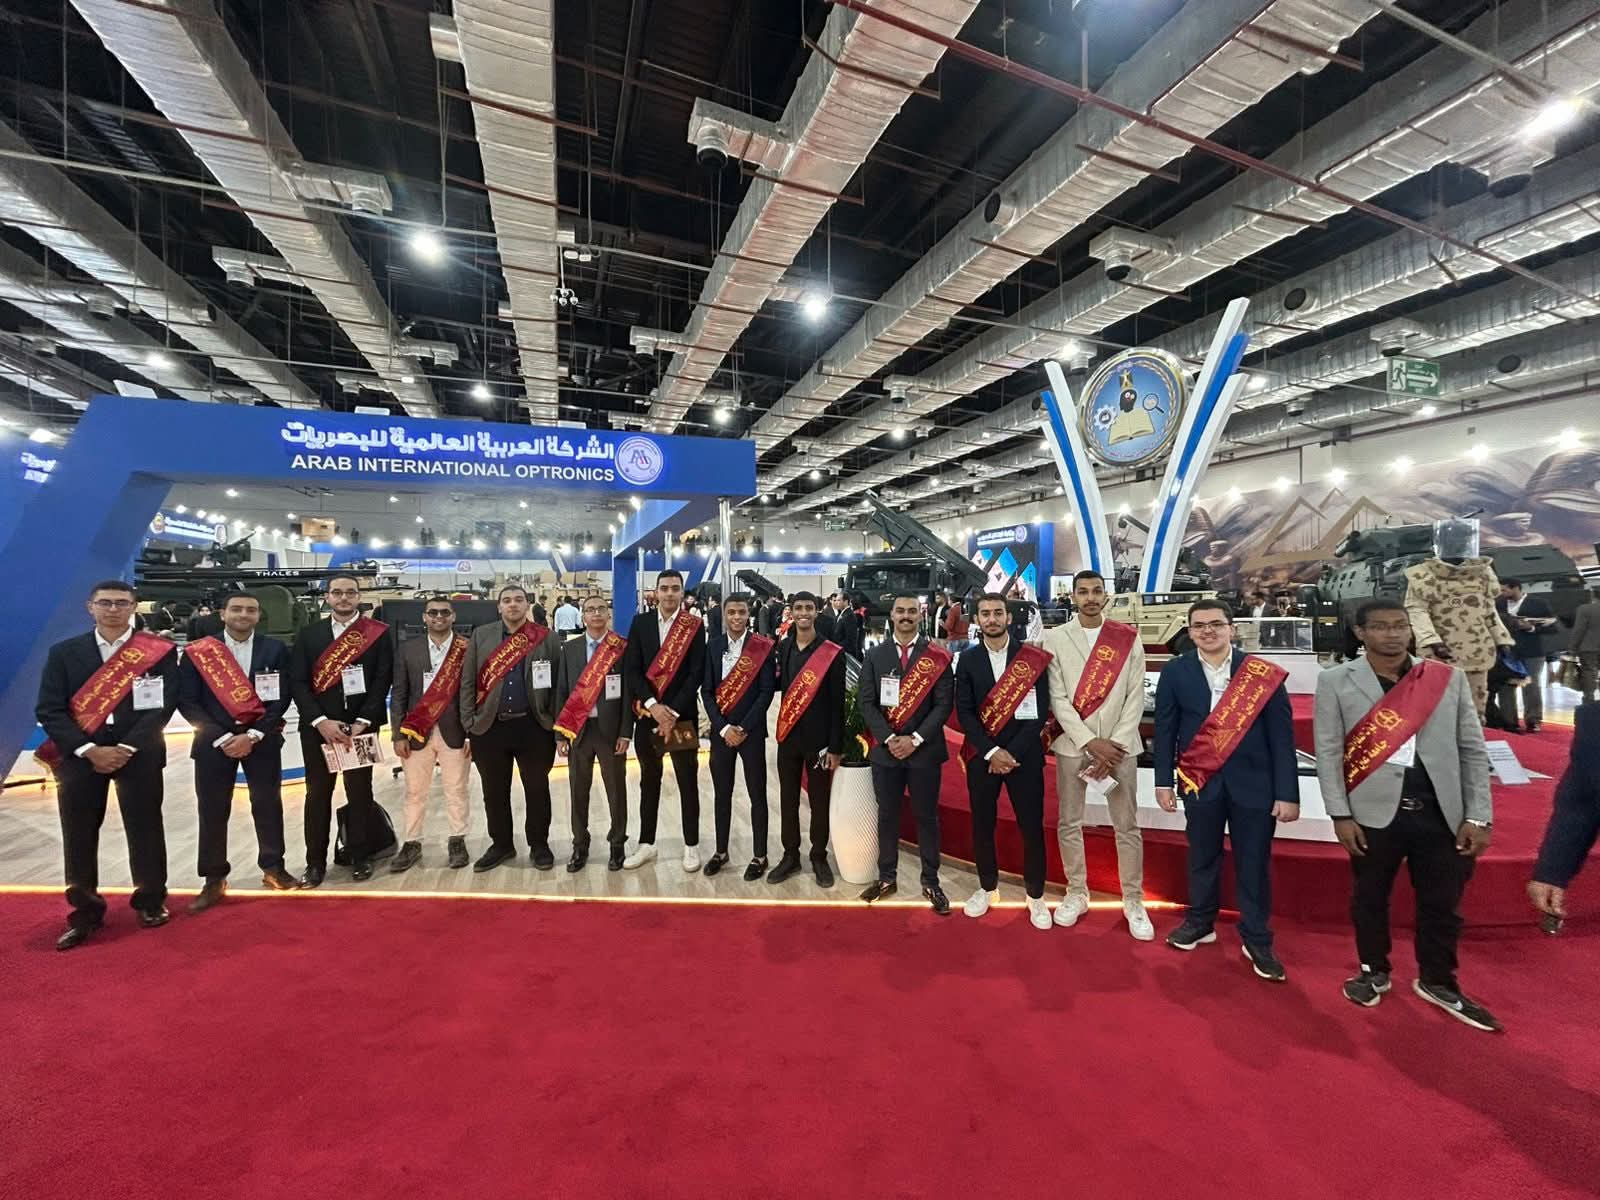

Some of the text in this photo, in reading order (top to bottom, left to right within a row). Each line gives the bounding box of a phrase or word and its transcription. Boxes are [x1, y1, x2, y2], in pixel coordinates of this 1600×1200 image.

[281, 421, 388, 452] للبصريات
[389, 427, 475, 454] العالمية
[477, 431, 544, 458] العربية
[546, 434, 614, 460] الشركة
[291, 454, 615, 481] ARAB INTERNATIONAL OPTRONICS
